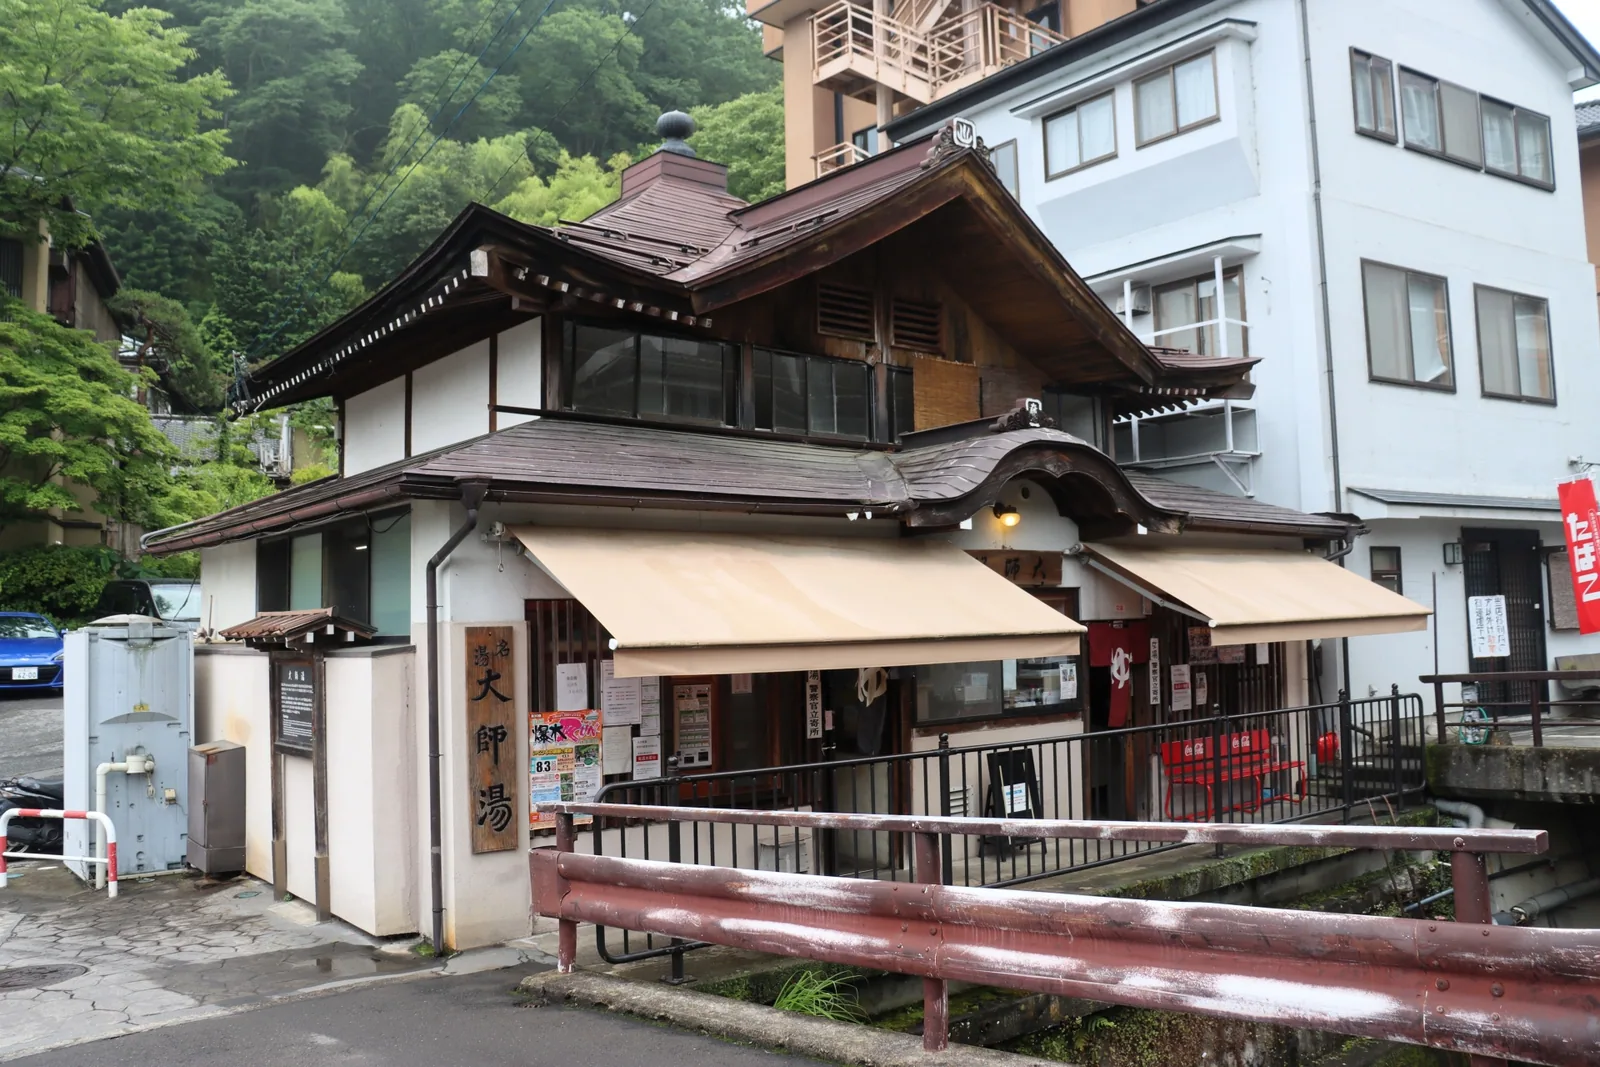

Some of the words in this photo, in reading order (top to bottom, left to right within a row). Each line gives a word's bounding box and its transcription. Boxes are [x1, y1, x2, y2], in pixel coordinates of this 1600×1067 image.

[1566, 512, 1600, 603] たばこ
[809, 684, 819, 737] 警察官立寄所
[471, 668, 513, 832] 大師湯
[1184, 743, 1204, 757] CocCola
[1232, 735, 1250, 749] CocCola
